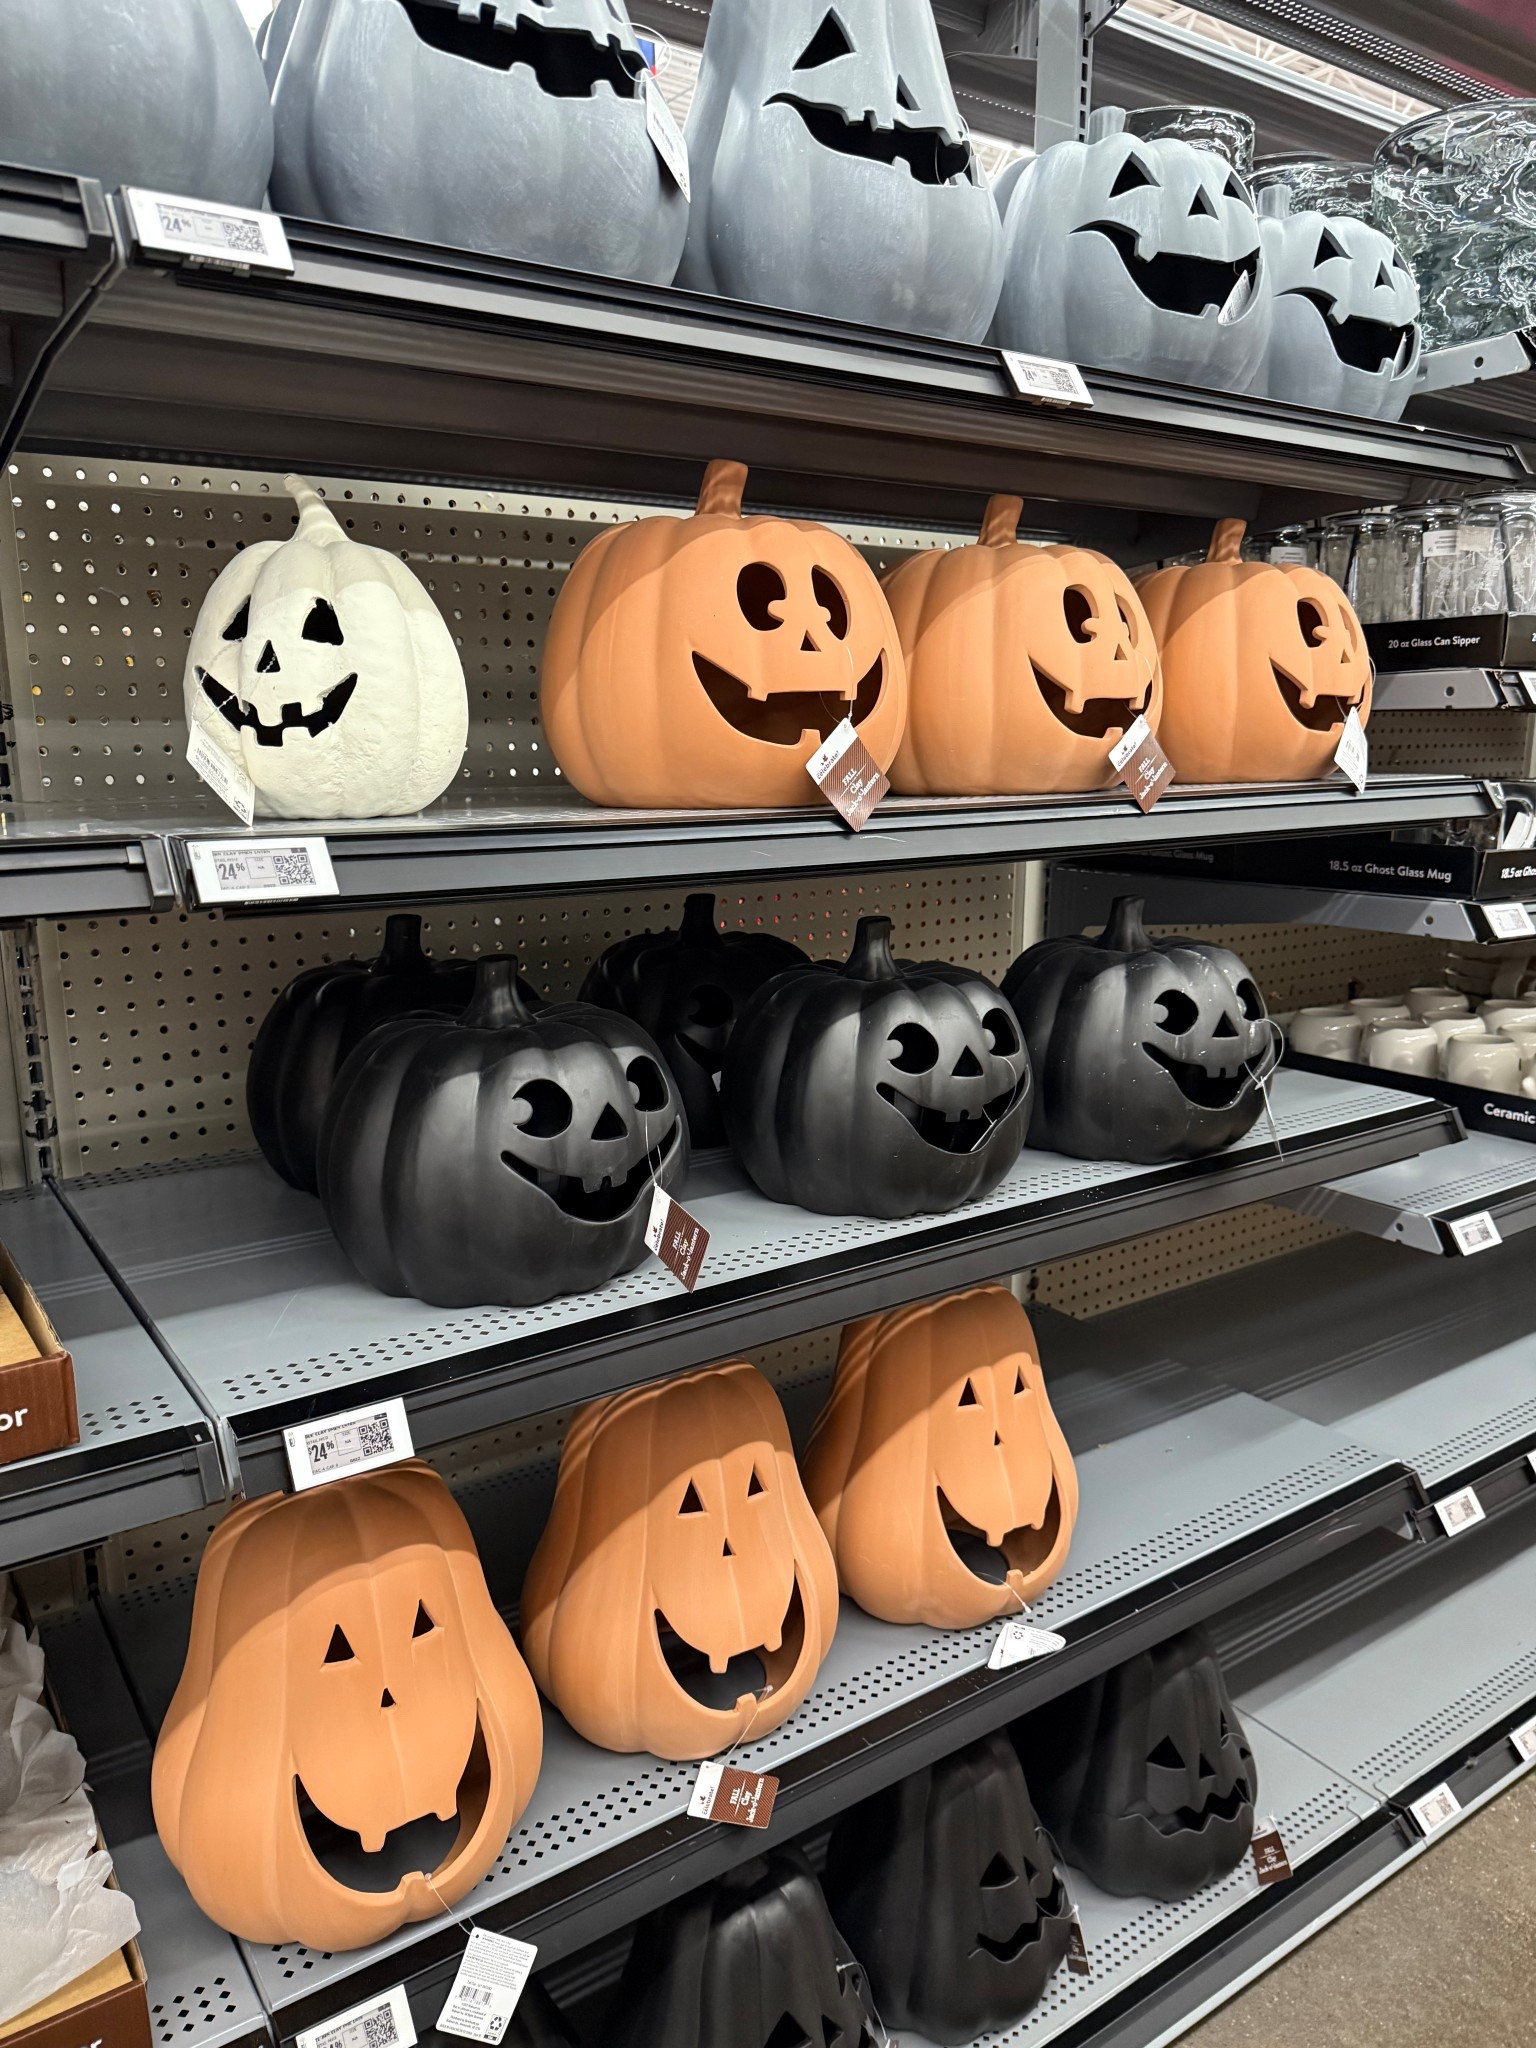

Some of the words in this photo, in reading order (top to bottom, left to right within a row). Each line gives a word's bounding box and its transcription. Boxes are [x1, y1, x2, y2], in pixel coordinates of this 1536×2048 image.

[1388, 640, 1399, 649] 20
[1411, 638, 1432, 647] Glass
[1434, 637, 1450, 646] Can
[1452, 636, 1480, 647] Sipper
[816, 750, 840, 780] celebrate!
[842, 768, 857, 786] FALL
[850, 778, 863, 794] Clay
[1329, 860, 1349, 871] 18.5
[1364, 863, 1395, 875] Ghost
[1397, 865, 1424, 878] Glass
[1426, 868, 1452, 883] Mug
[1501, 867, 1516, 879] 18.5
[1483, 1102, 1536, 1124] Ceramic
[672, 1230, 681, 1250] FALL
[680, 1238, 688, 1255] Clay
[729, 1788, 740, 1805] FALL
[741, 1791, 752, 1806] Clay
